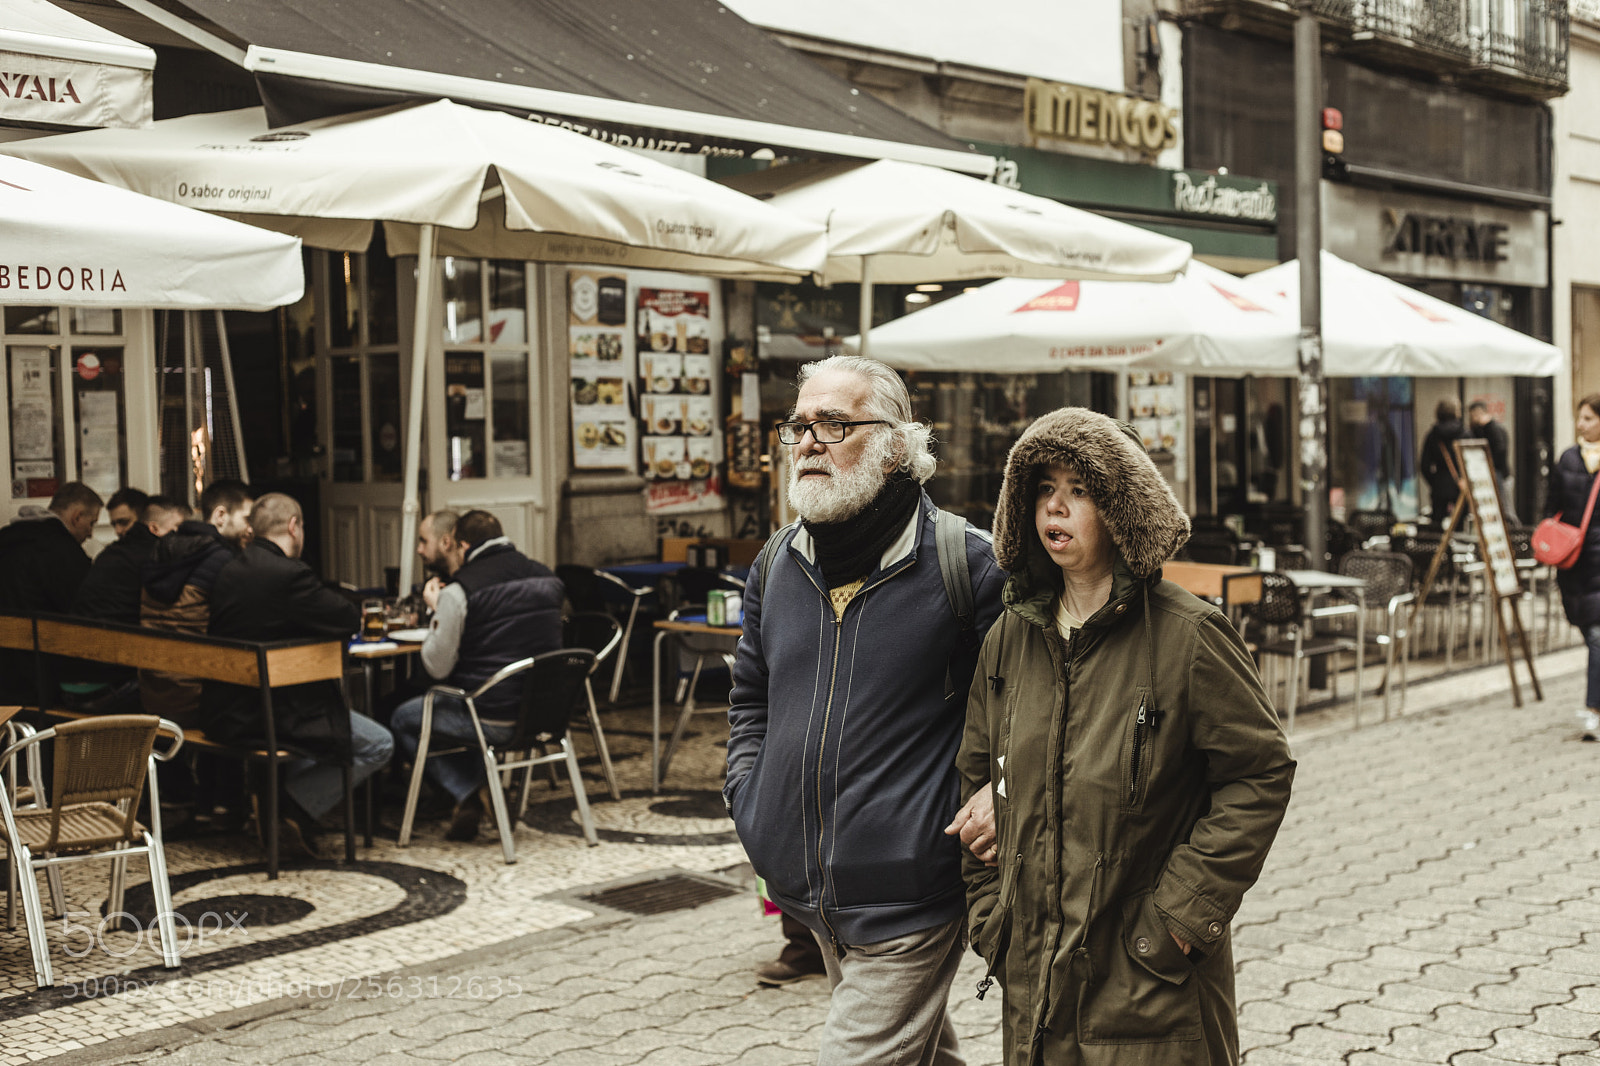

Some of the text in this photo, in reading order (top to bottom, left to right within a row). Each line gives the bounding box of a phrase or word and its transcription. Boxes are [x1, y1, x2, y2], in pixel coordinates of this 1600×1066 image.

[178, 182, 272, 203] O sabor original
[0, 265, 126, 291] BEDORIA
